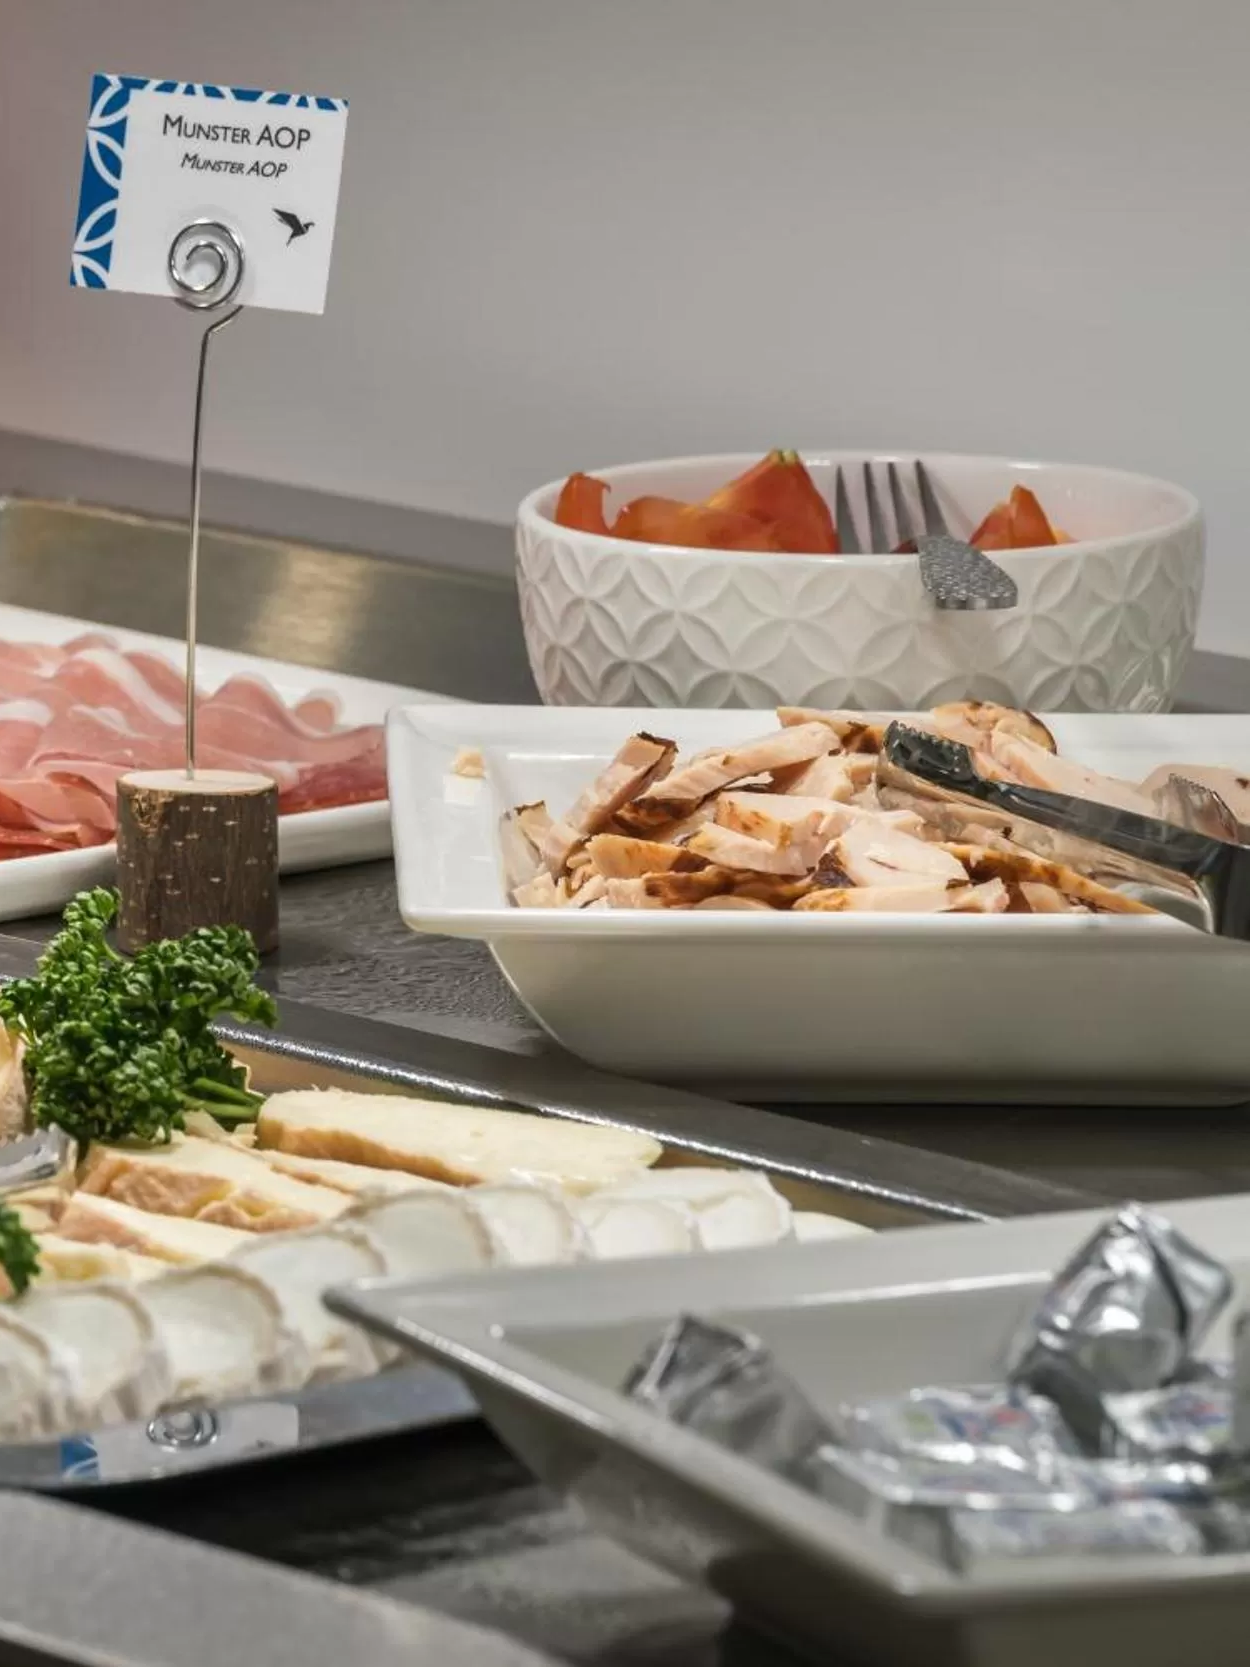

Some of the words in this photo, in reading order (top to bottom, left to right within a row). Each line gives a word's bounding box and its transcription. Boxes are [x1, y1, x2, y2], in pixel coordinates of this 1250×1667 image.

[162, 113, 251, 146] MUNSTER
[255, 124, 311, 151] AOP
[180, 153, 245, 175] MUNSTER
[246, 160, 288, 179] AOP
